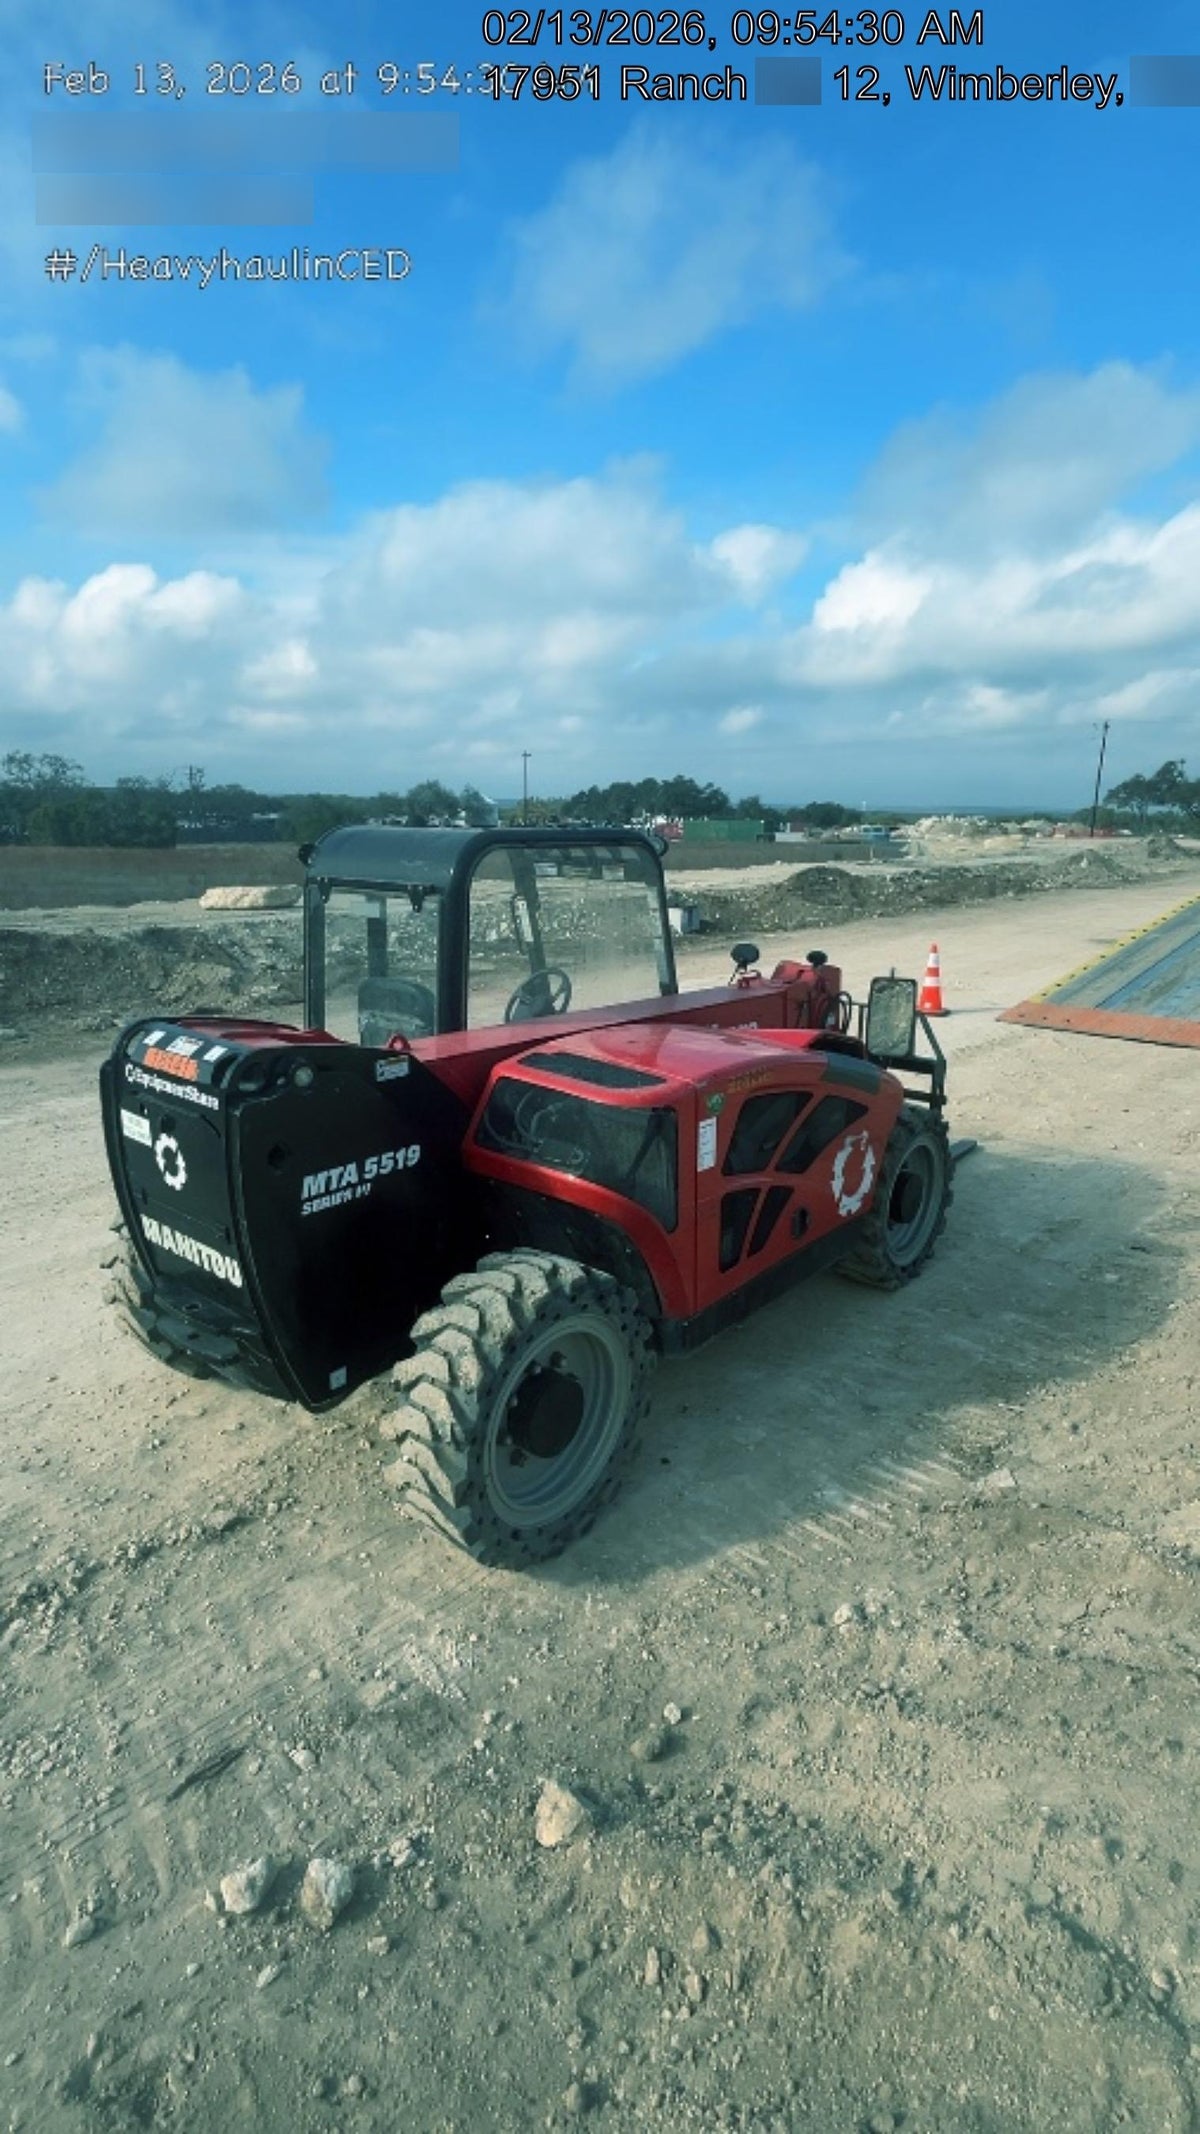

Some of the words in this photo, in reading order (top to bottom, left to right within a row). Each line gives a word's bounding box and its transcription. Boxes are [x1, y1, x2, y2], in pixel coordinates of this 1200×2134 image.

[301, 1162, 359, 1200] MTA
[364, 1144, 421, 1179] 5519
[140, 1213, 243, 1288] MANITOU
